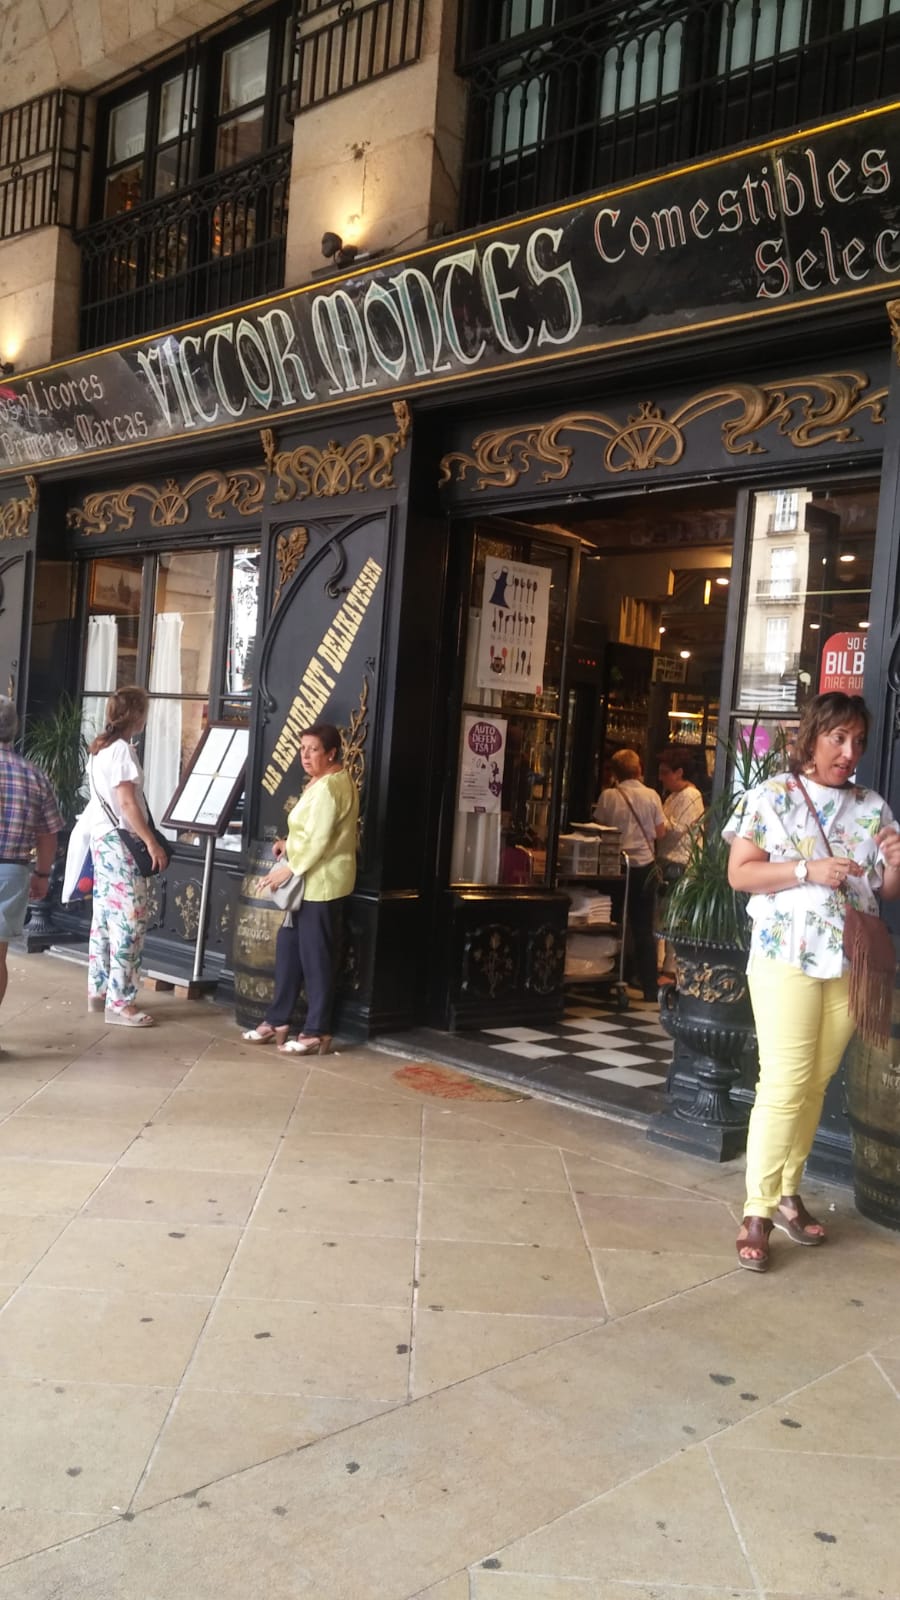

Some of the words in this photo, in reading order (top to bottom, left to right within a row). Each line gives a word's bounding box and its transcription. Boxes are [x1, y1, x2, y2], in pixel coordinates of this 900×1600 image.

[594, 148, 891, 263] Comestibles
[136, 308, 315, 429] VICTOR
[310, 227, 583, 396] MONTES
[27, 374, 104, 416] Licores
[0, 428, 79, 465] Primeras
[76, 411, 149, 449] Marcas
[825, 651, 865, 675] BILB
[847, 637, 860, 650] YO
[260, 763, 283, 797] BAR
[272, 656, 337, 773] RESTAURANT
[316, 556, 384, 675] DELIKATESSEN
[472, 733, 497, 744] DEFEN
[474, 724, 496, 736] AUTO
